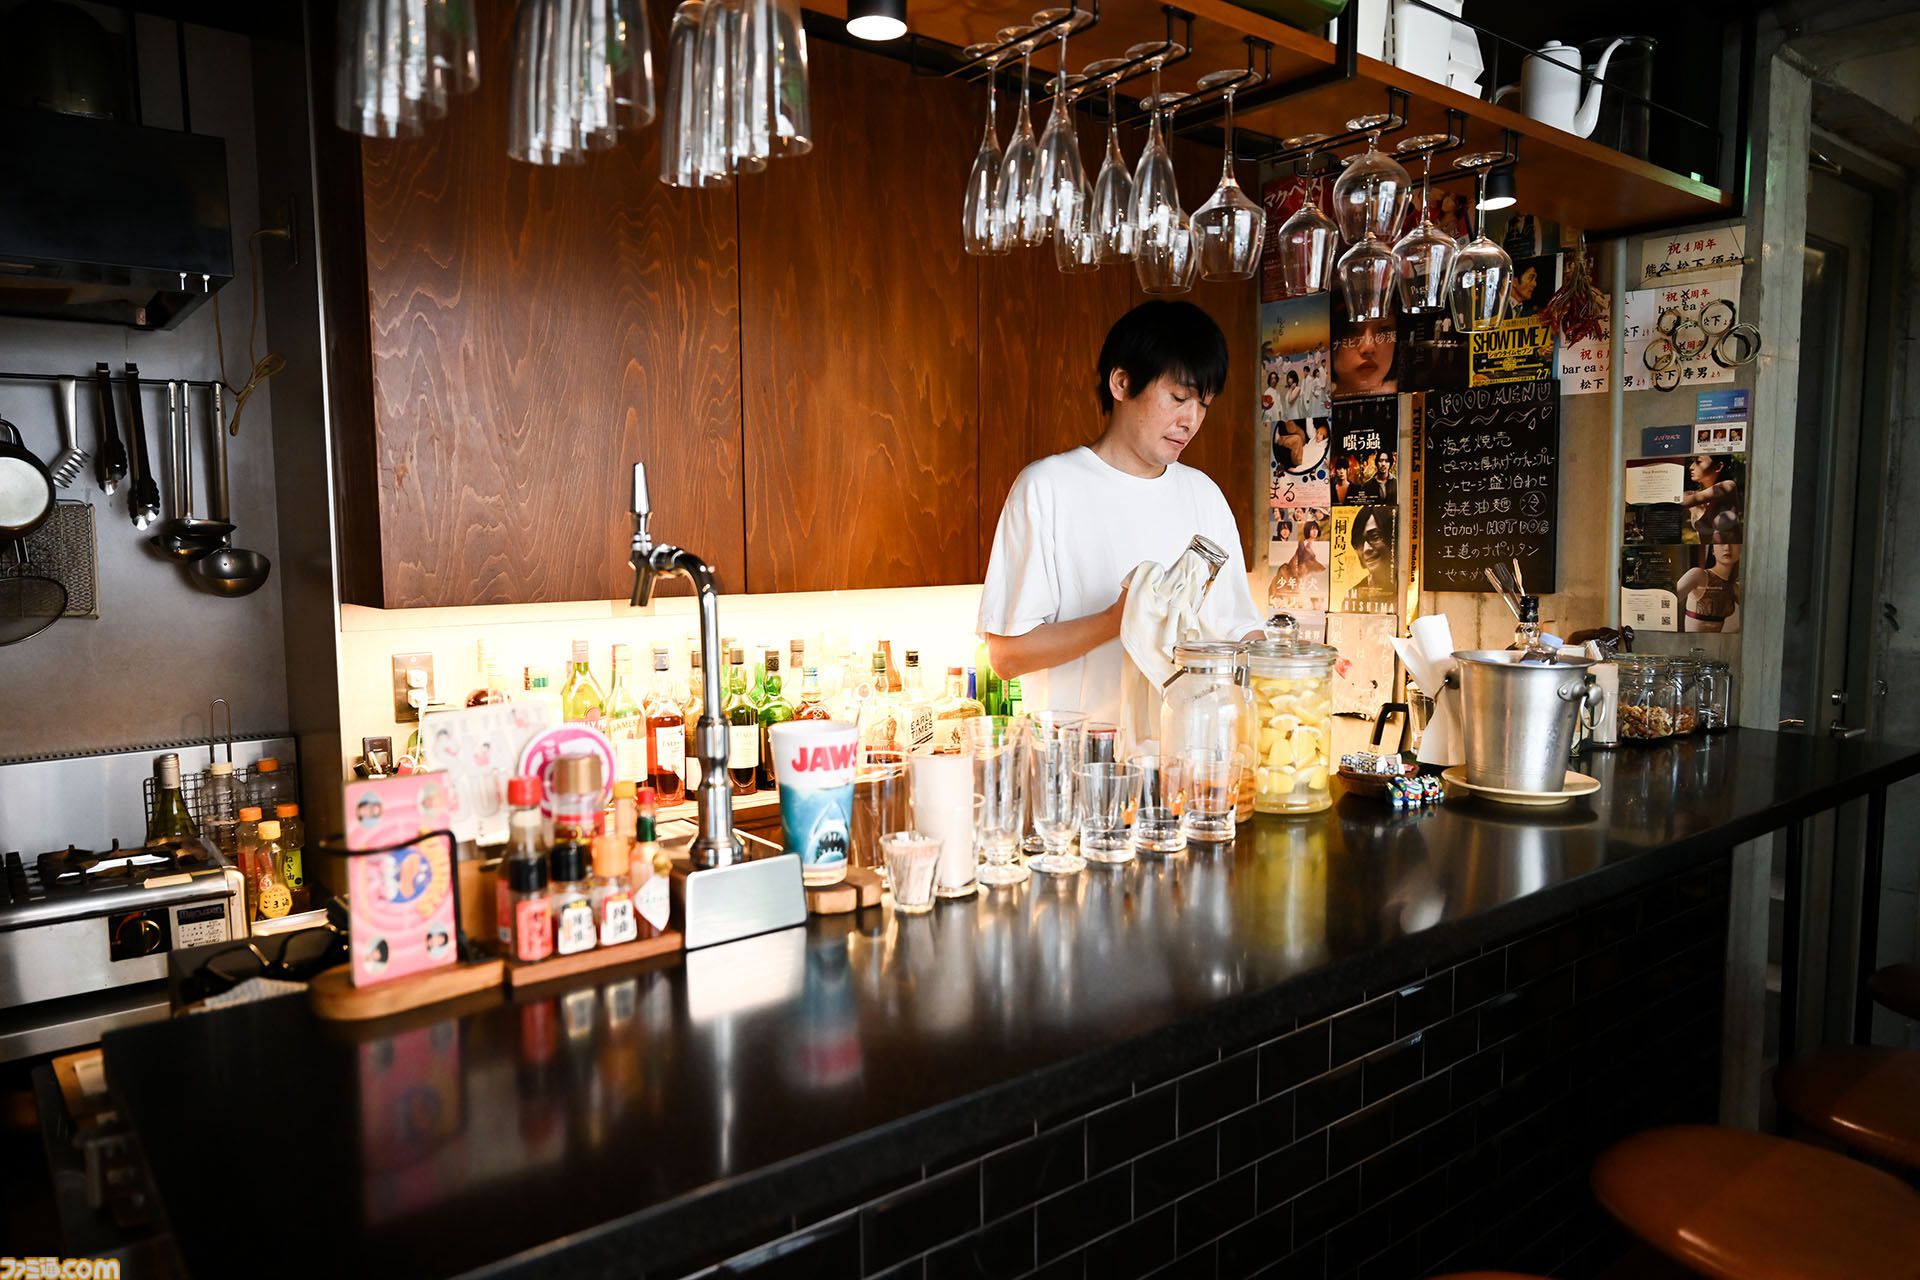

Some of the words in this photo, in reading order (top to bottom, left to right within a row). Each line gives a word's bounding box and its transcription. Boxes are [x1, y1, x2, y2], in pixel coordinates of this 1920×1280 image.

[1473, 328, 1539, 353] SHOWTIME
[1540, 326, 1550, 347] 7
[1562, 364, 1581, 375] bar
[1584, 364, 1597, 373] ea
[1580, 377, 1605, 390] 松下
[1441, 389, 1490, 415] FOOD
[1491, 382, 1551, 405] MENU
[1411, 407, 1421, 472] TUNNELS
[1270, 478, 1295, 502] まる
[1486, 519, 1518, 535] HOT
[1520, 519, 1550, 534] DOG
[1443, 541, 1540, 560] 王道のナポリタン
[1276, 576, 1319, 590] 少年と犬
[910, 711, 933, 730] EARLY
[911, 720, 933, 739] TIMES
